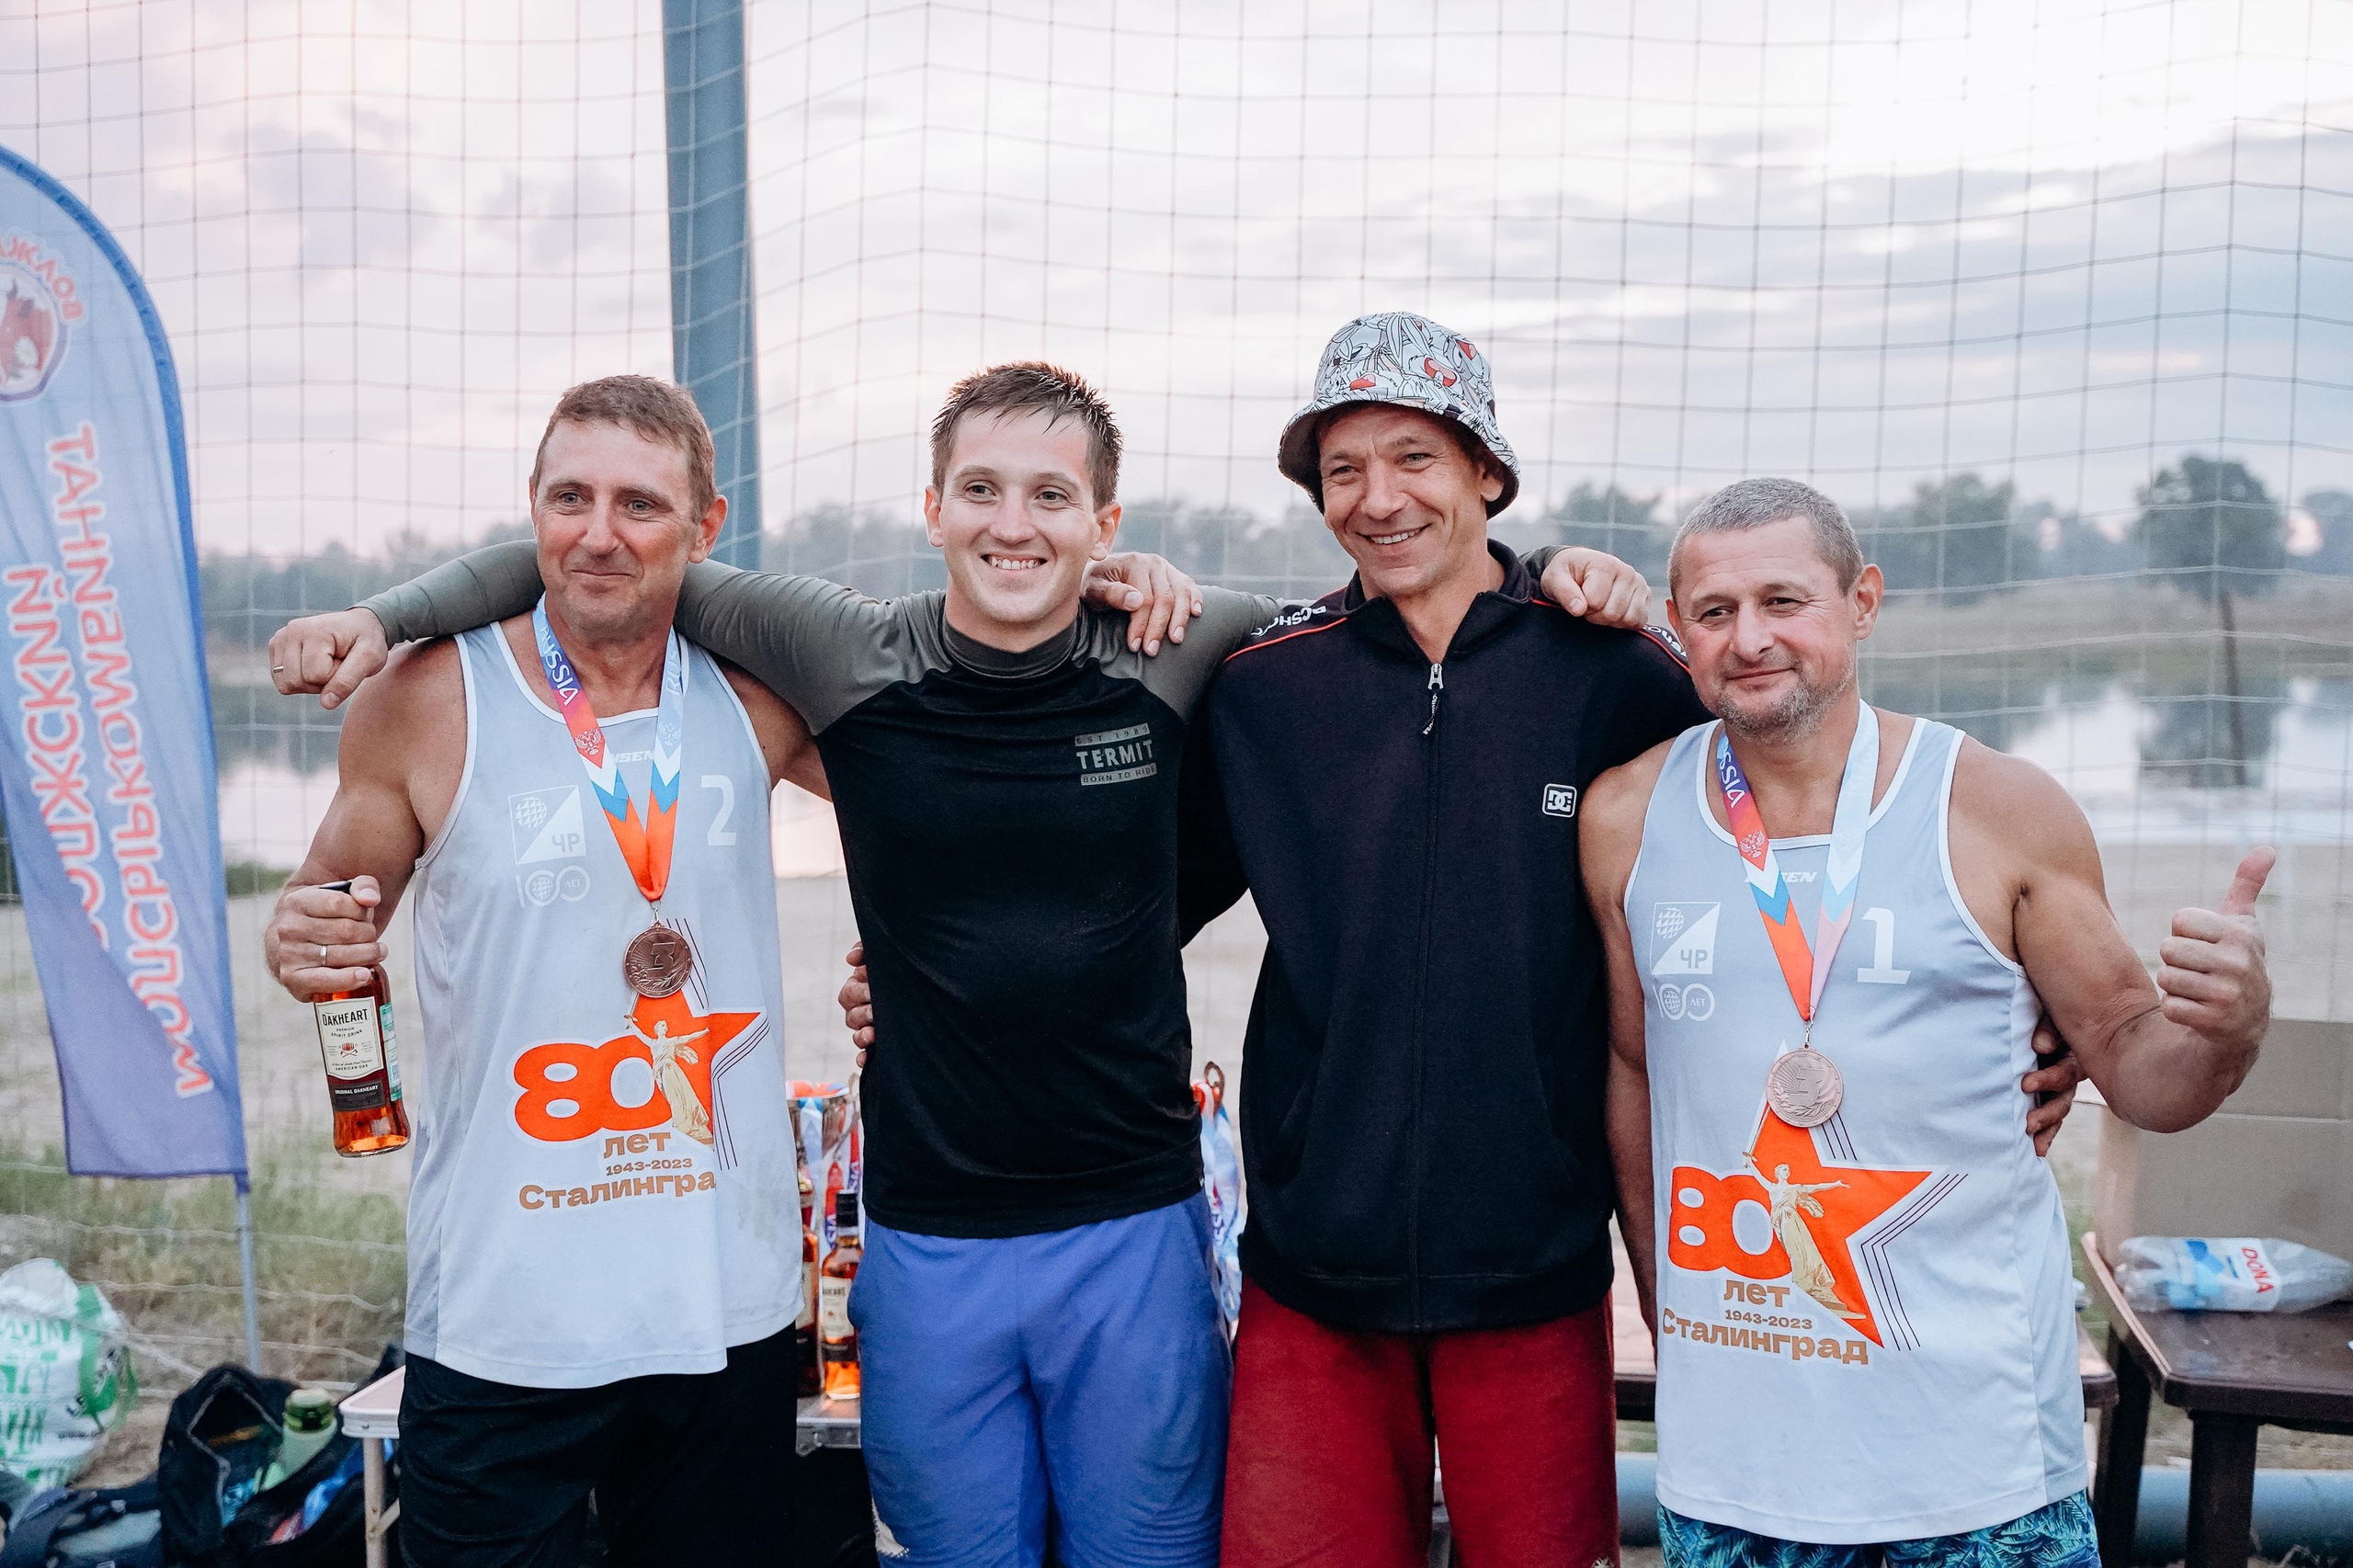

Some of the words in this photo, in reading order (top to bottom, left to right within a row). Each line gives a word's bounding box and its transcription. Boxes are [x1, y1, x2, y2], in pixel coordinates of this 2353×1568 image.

[540, 626, 579, 707] RUSSIA
[1076, 735, 1104, 744] EST
[1076, 739, 1153, 769] TERMIT
[1083, 775, 1113, 783] BORN
[1135, 766, 1156, 778] RIDE
[1719, 750, 1745, 809] SSIA
[700, 775, 737, 846] 2
[1547, 790, 1573, 812] DC
[1857, 907, 1911, 984] 1
[323, 1009, 368, 1026] OAKHEART
[514, 1035, 674, 1142] 80
[603, 1131, 671, 1159] лет
[607, 1158, 693, 1176] 1943-2023
[519, 1171, 715, 1210] Сталингра
[1723, 1279, 1790, 1308] лет
[1725, 1309, 1813, 1330] 1943-2023
[1663, 1308, 1869, 1365] Сталинград
